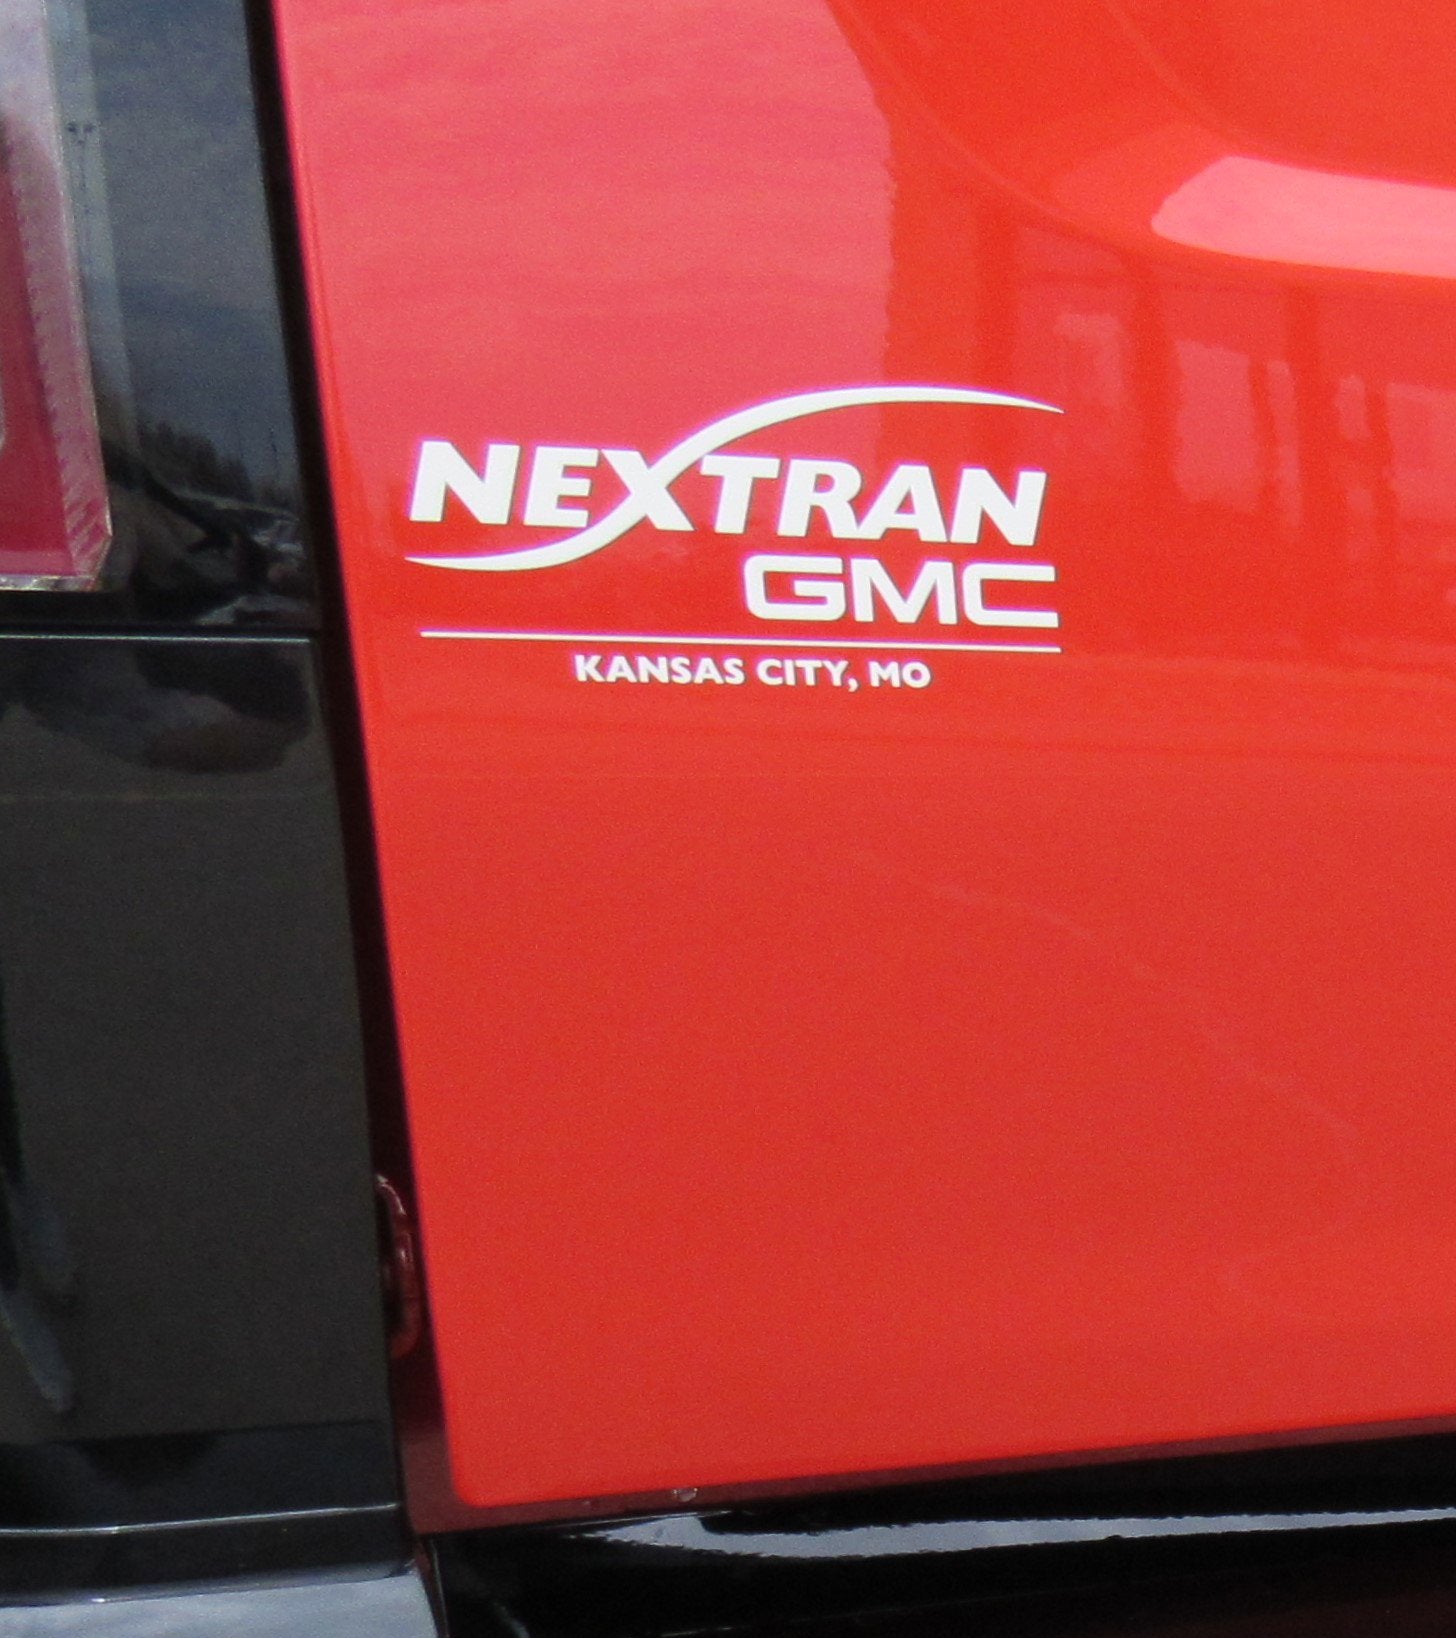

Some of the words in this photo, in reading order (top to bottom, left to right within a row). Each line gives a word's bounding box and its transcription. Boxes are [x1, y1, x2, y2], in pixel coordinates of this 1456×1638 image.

[409, 440, 1047, 547] NEXTRAN
[742, 554, 1060, 629] GMC
[574, 655, 746, 687] KANSAS
[756, 657, 859, 693] CITY,
[870, 661, 932, 690] MO
